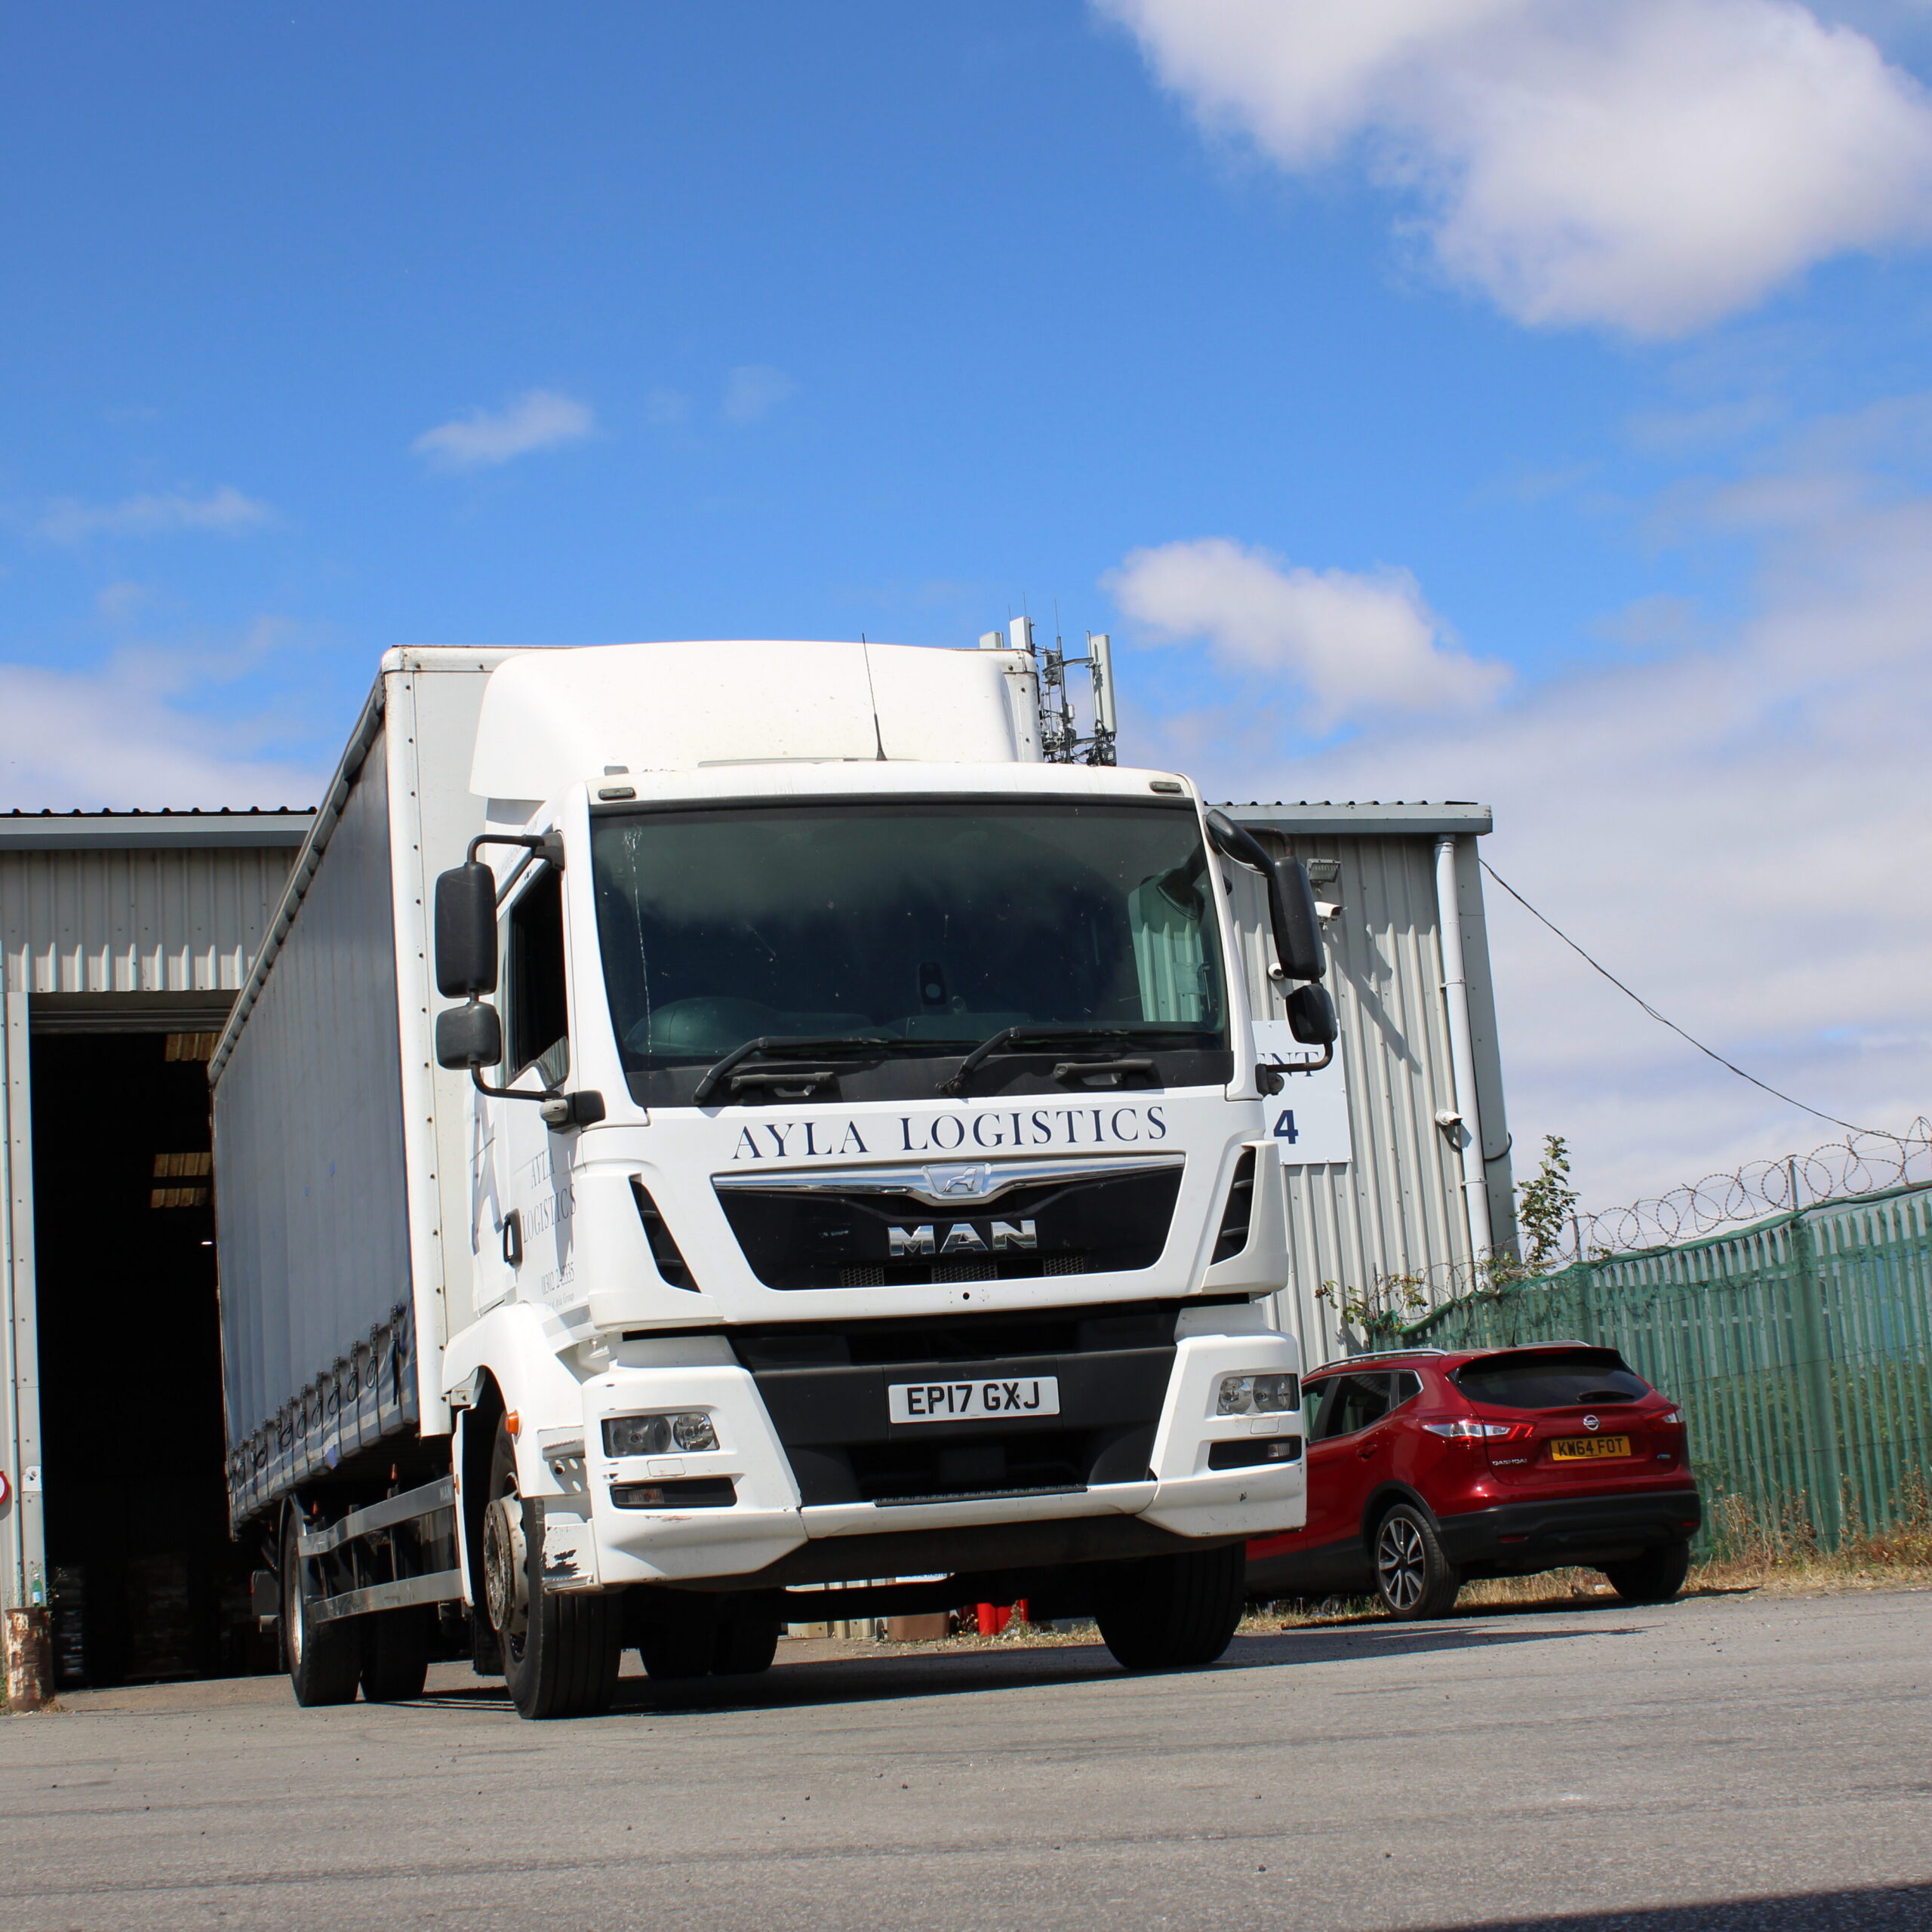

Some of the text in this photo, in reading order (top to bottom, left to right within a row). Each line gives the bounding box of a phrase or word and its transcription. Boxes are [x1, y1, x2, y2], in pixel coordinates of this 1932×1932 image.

[1256, 1051, 1319, 1078] NT
[732, 1106, 1168, 1160] AYLA LOGISTICS
[1273, 1109, 1299, 1144] 4
[531, 1148, 555, 1189] AYLA
[522, 1183, 576, 1244] LOGISTICS
[888, 1220, 1038, 1257] MAN
[907, 1381, 1040, 1416] EP17 GXJ
[1558, 1438, 1623, 1457] KW64 FOT
